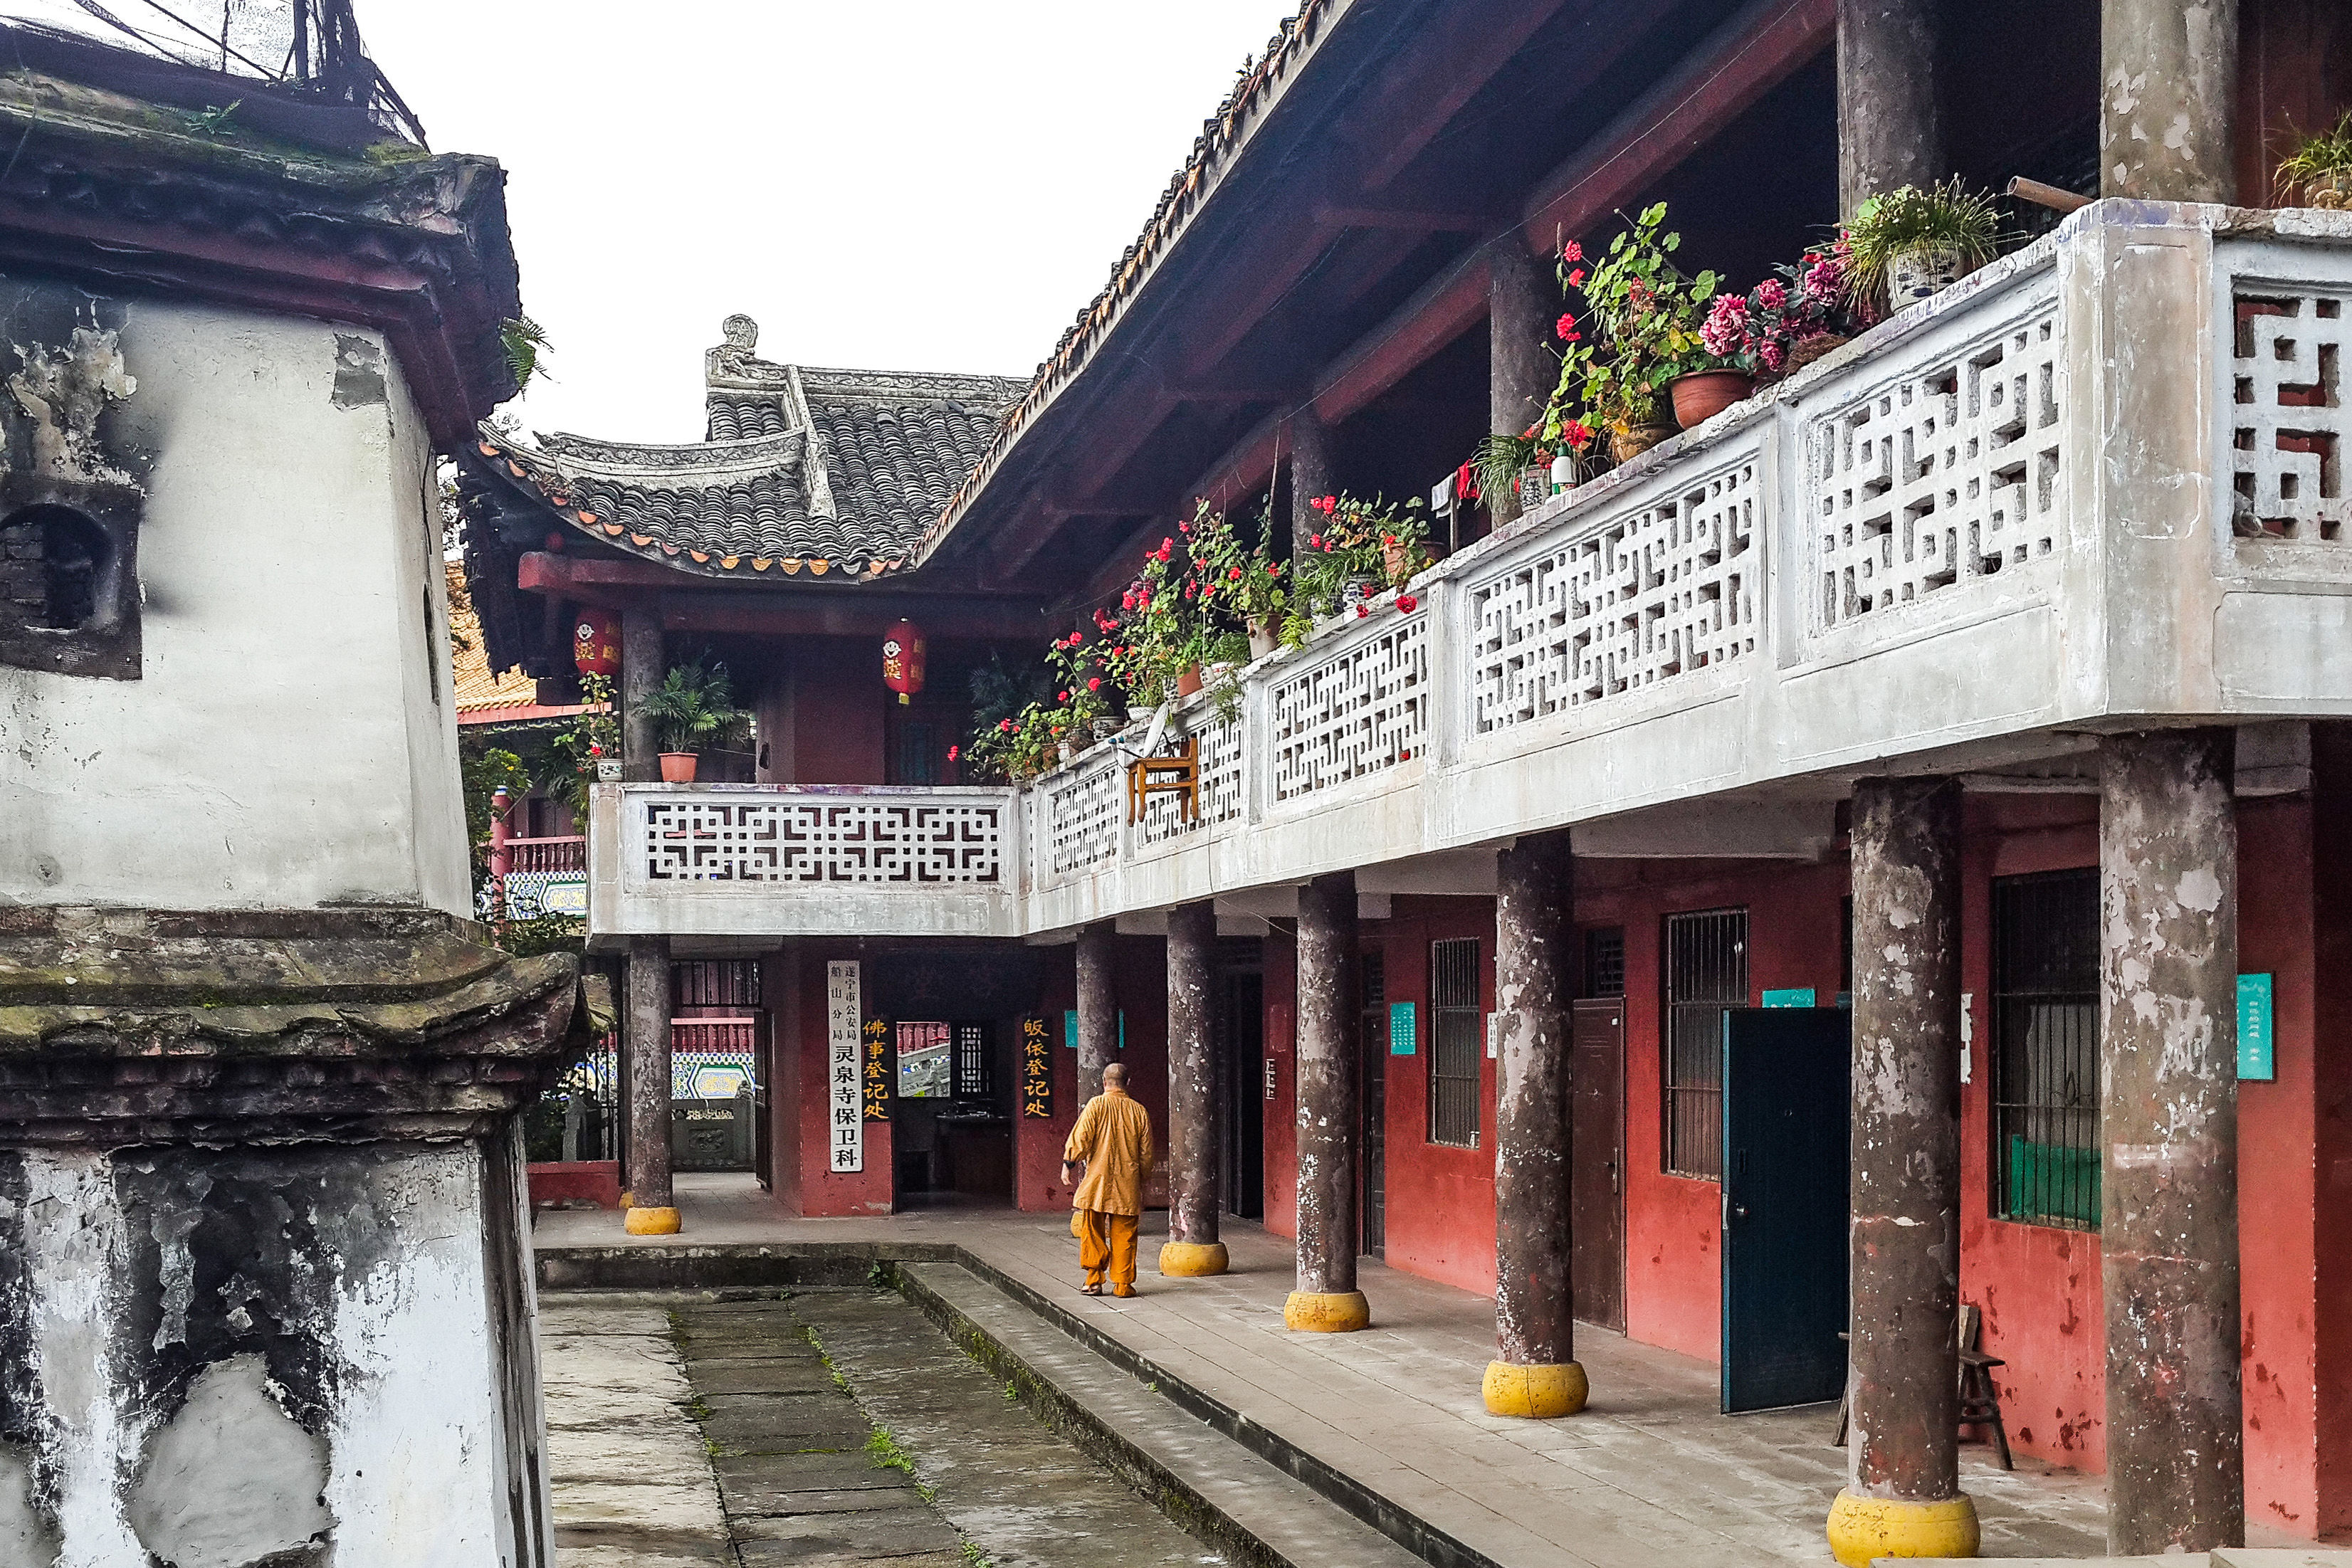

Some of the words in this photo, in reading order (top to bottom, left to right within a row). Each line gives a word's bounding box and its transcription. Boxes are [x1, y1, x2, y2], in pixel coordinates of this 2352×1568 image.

[834, 1046, 857, 1167] 灵泉寺保卫科
[863, 1020, 889, 1120] 佛事登记处
[1024, 1019, 1050, 1117] 皈依登记处
